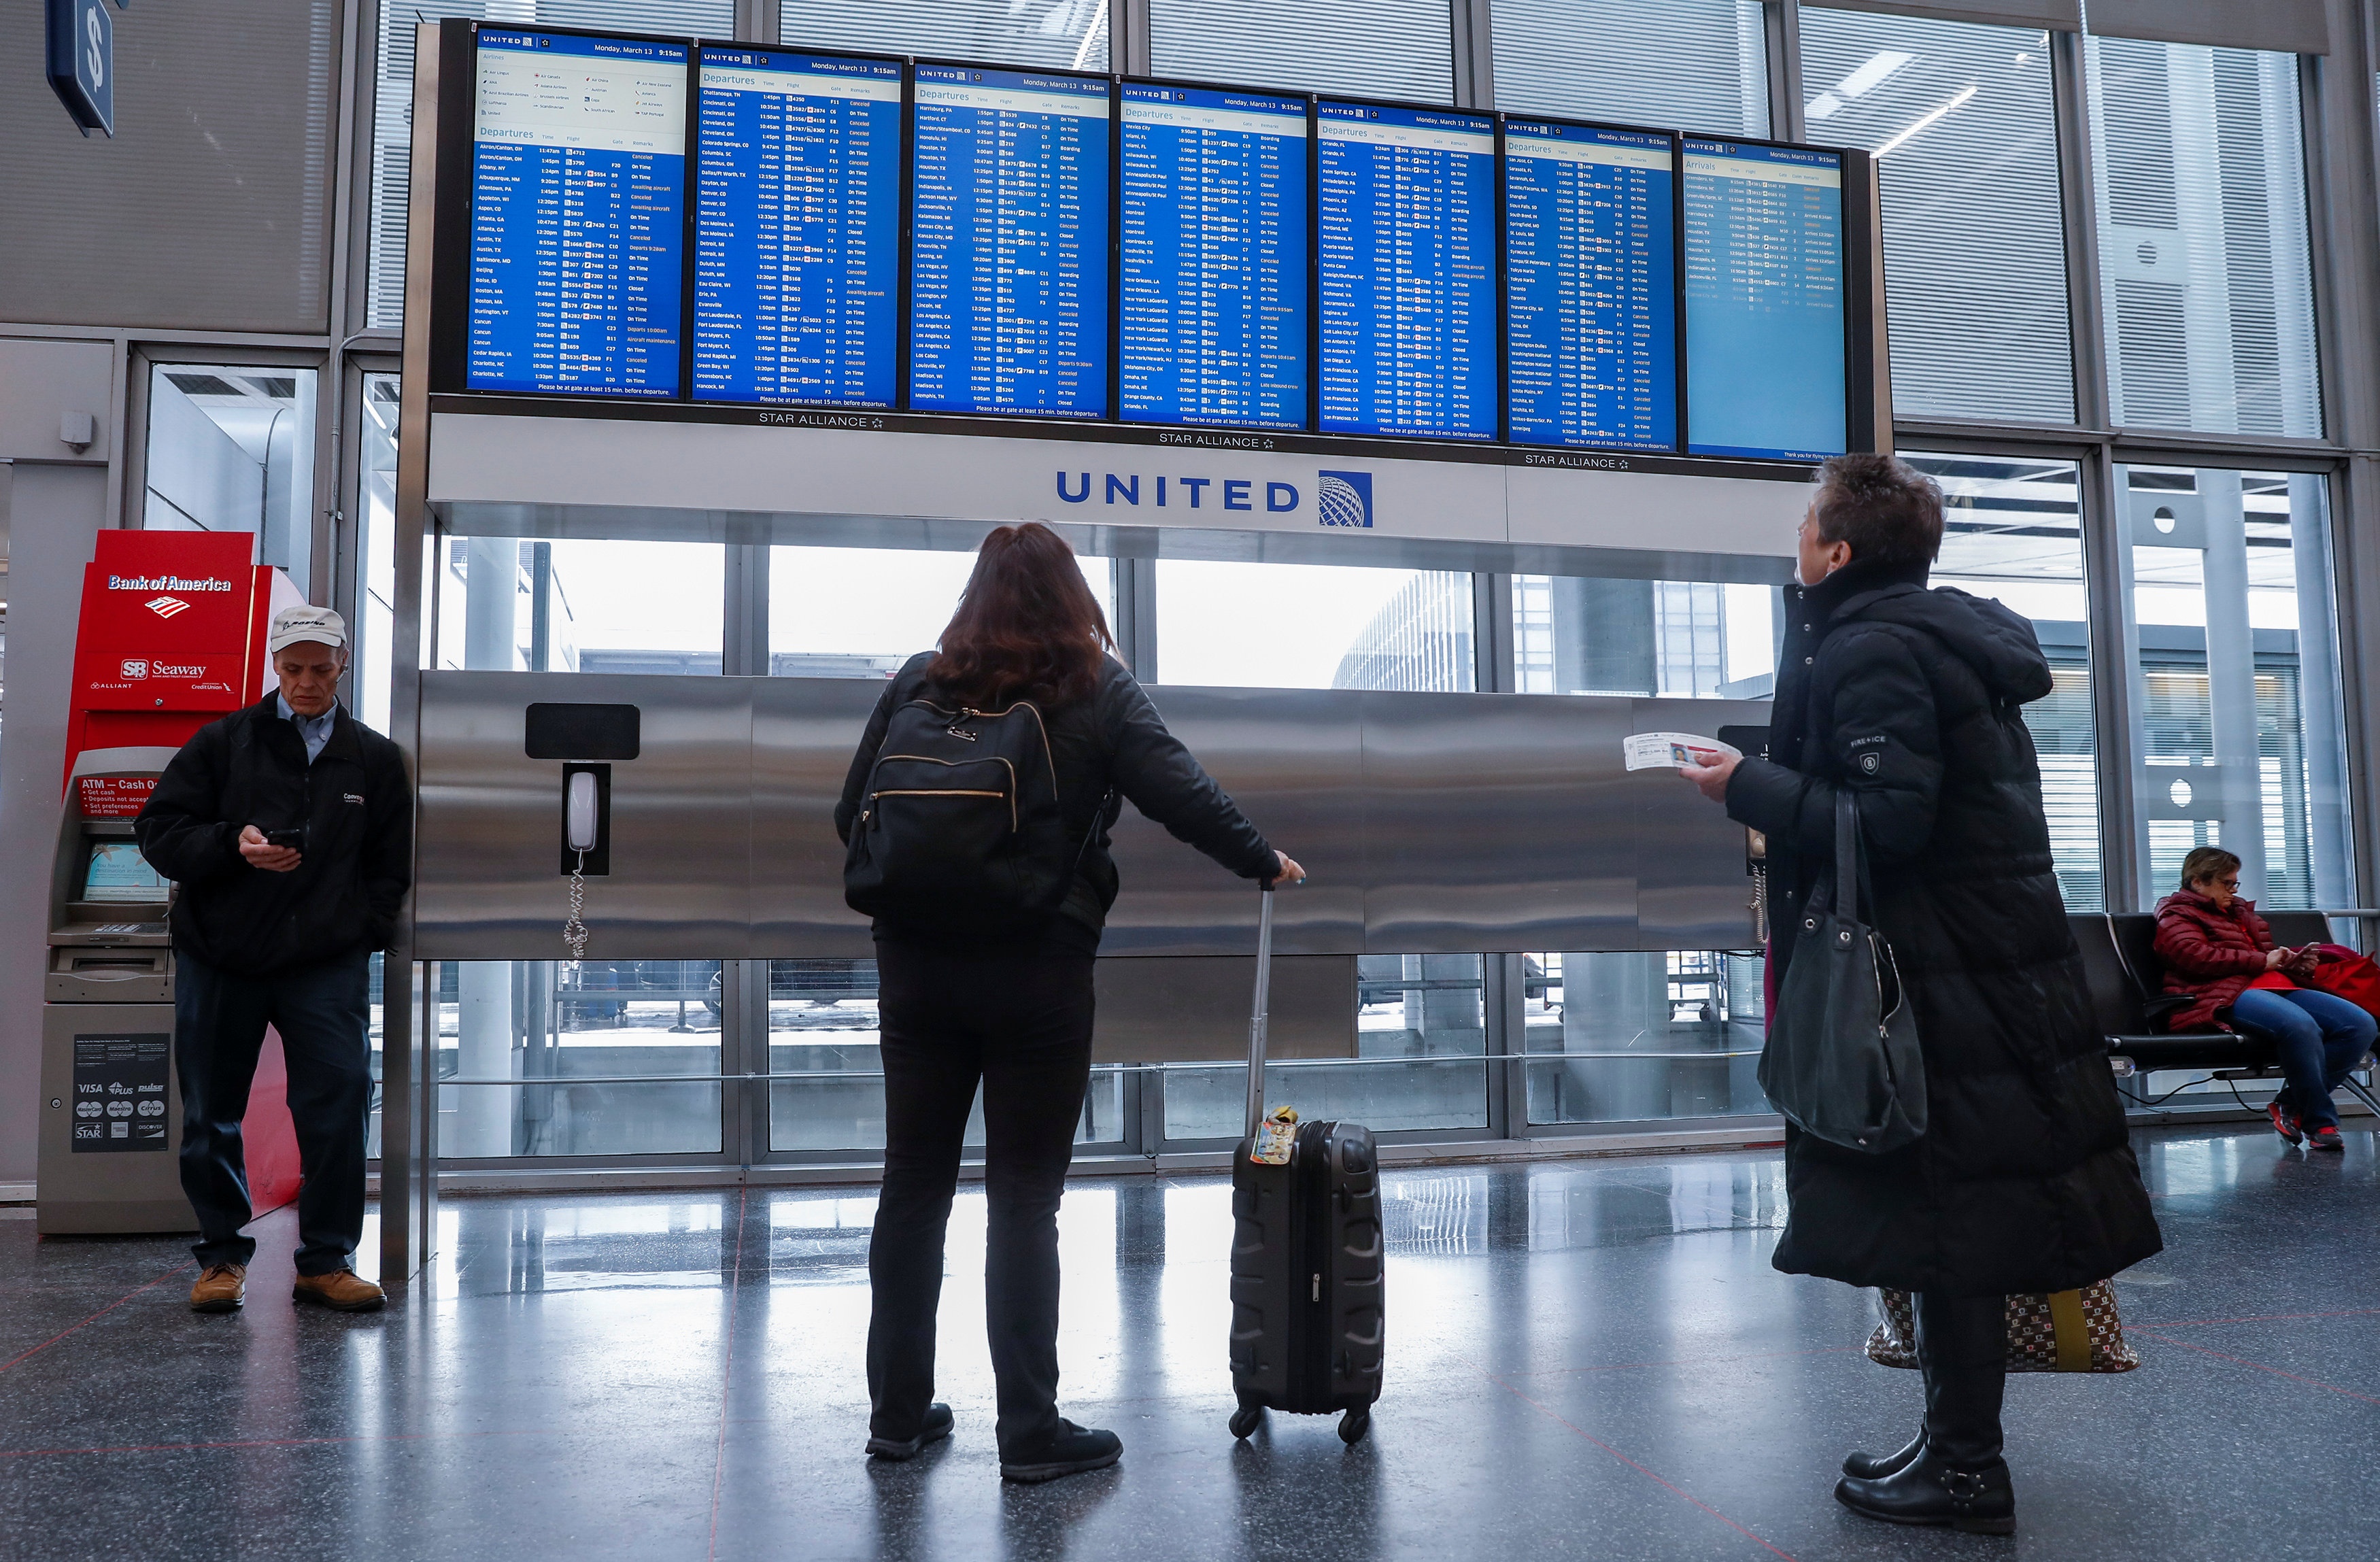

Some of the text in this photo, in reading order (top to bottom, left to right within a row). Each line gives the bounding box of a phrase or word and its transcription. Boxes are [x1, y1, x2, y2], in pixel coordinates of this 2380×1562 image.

[483, 36, 521, 44] UNITED
[595, 44, 622, 53] Monday,
[812, 62, 838, 71] Monday,
[703, 73, 755, 84] Departures
[920, 70, 955, 78] UNITED
[1023, 79, 1048, 88] Monday,
[920, 90, 969, 101] Departures
[1225, 99, 1248, 107] Monday,
[1126, 109, 1173, 120] Departures
[1416, 116, 1439, 124] Monday,
[480, 127, 533, 139] Departures
[1323, 126, 1367, 137] Departures
[1508, 143, 1551, 154] Departures
[1686, 161, 1716, 170] Arrivals
[760, 413, 867, 427] STAR ALLIANCE
[1160, 434, 1259, 447] STAR ALLIANCE
[1525, 455, 1615, 468] STAR ALLIANCE
[1057, 471, 1299, 513] UNITED
[109, 575, 231, 592] Bank of America
[152, 661, 206, 678] Seaway
[82, 779, 104, 788] ATM
[119, 780, 144, 789] Cash
[78, 1084, 103, 1093] VISA
[138, 1083, 165, 1092] pulse
[77, 1130, 100, 1138] STAR
